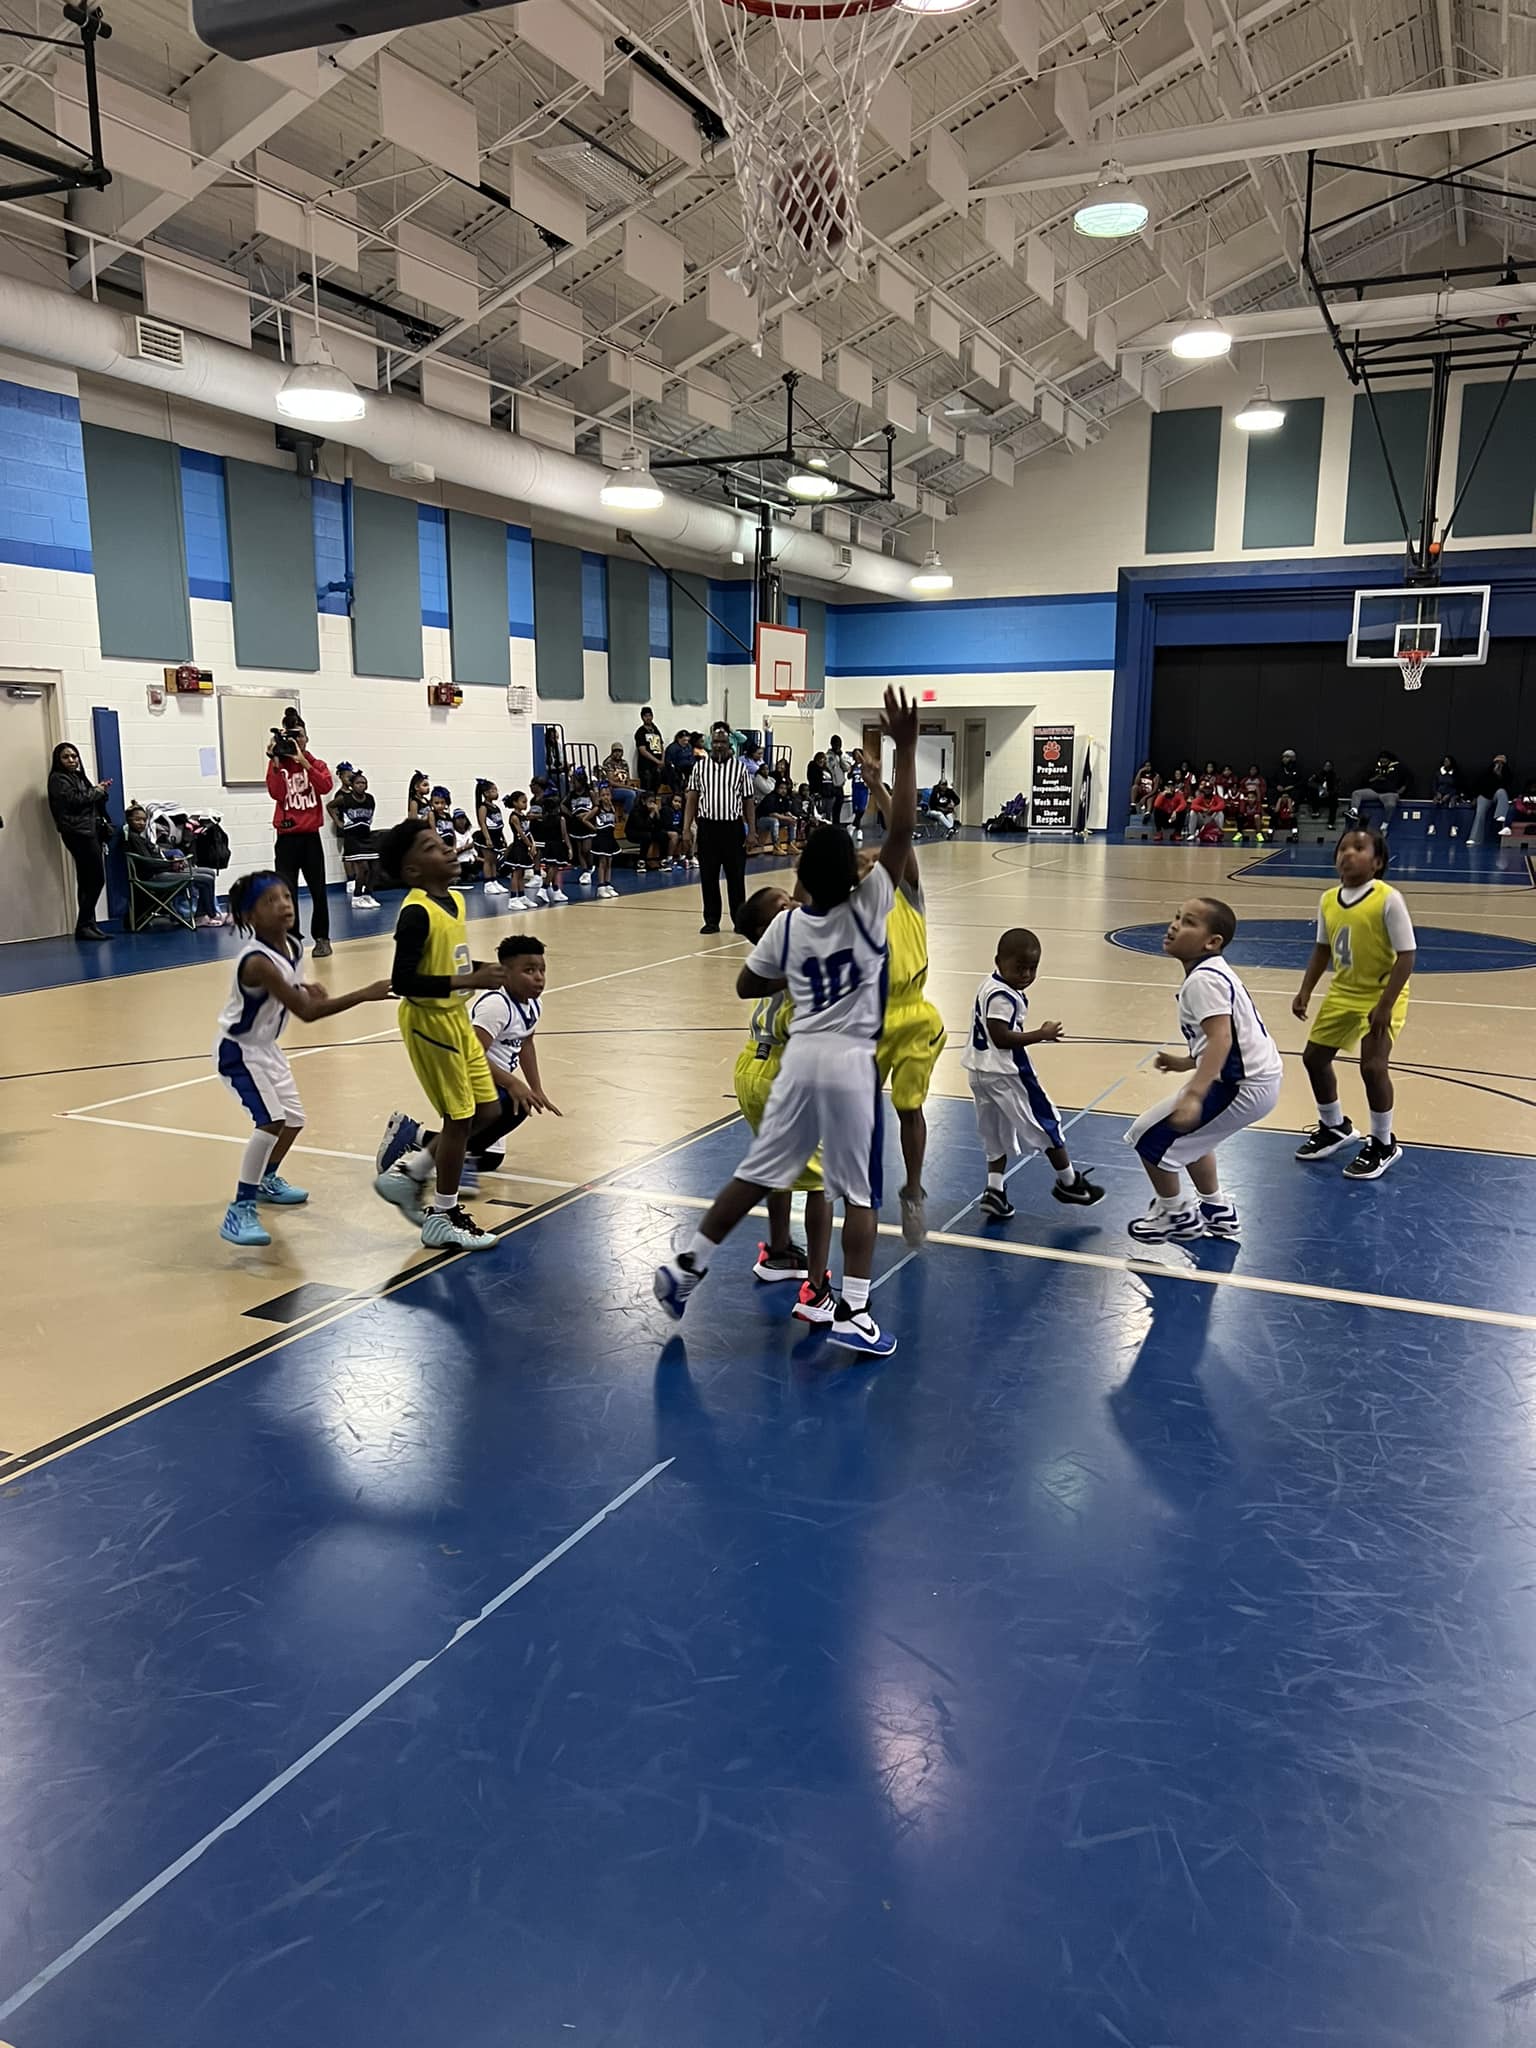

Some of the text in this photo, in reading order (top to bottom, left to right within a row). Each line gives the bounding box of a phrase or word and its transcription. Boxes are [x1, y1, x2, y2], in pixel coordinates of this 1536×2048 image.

[1037, 765, 1067, 775] Prepared
[1032, 785, 1072, 793] Responsibility
[1034, 798, 1070, 806] Work Hard
[1036, 815, 1065, 825] Respect
[1333, 925, 1354, 968] 4
[801, 948, 862, 1012] 10
